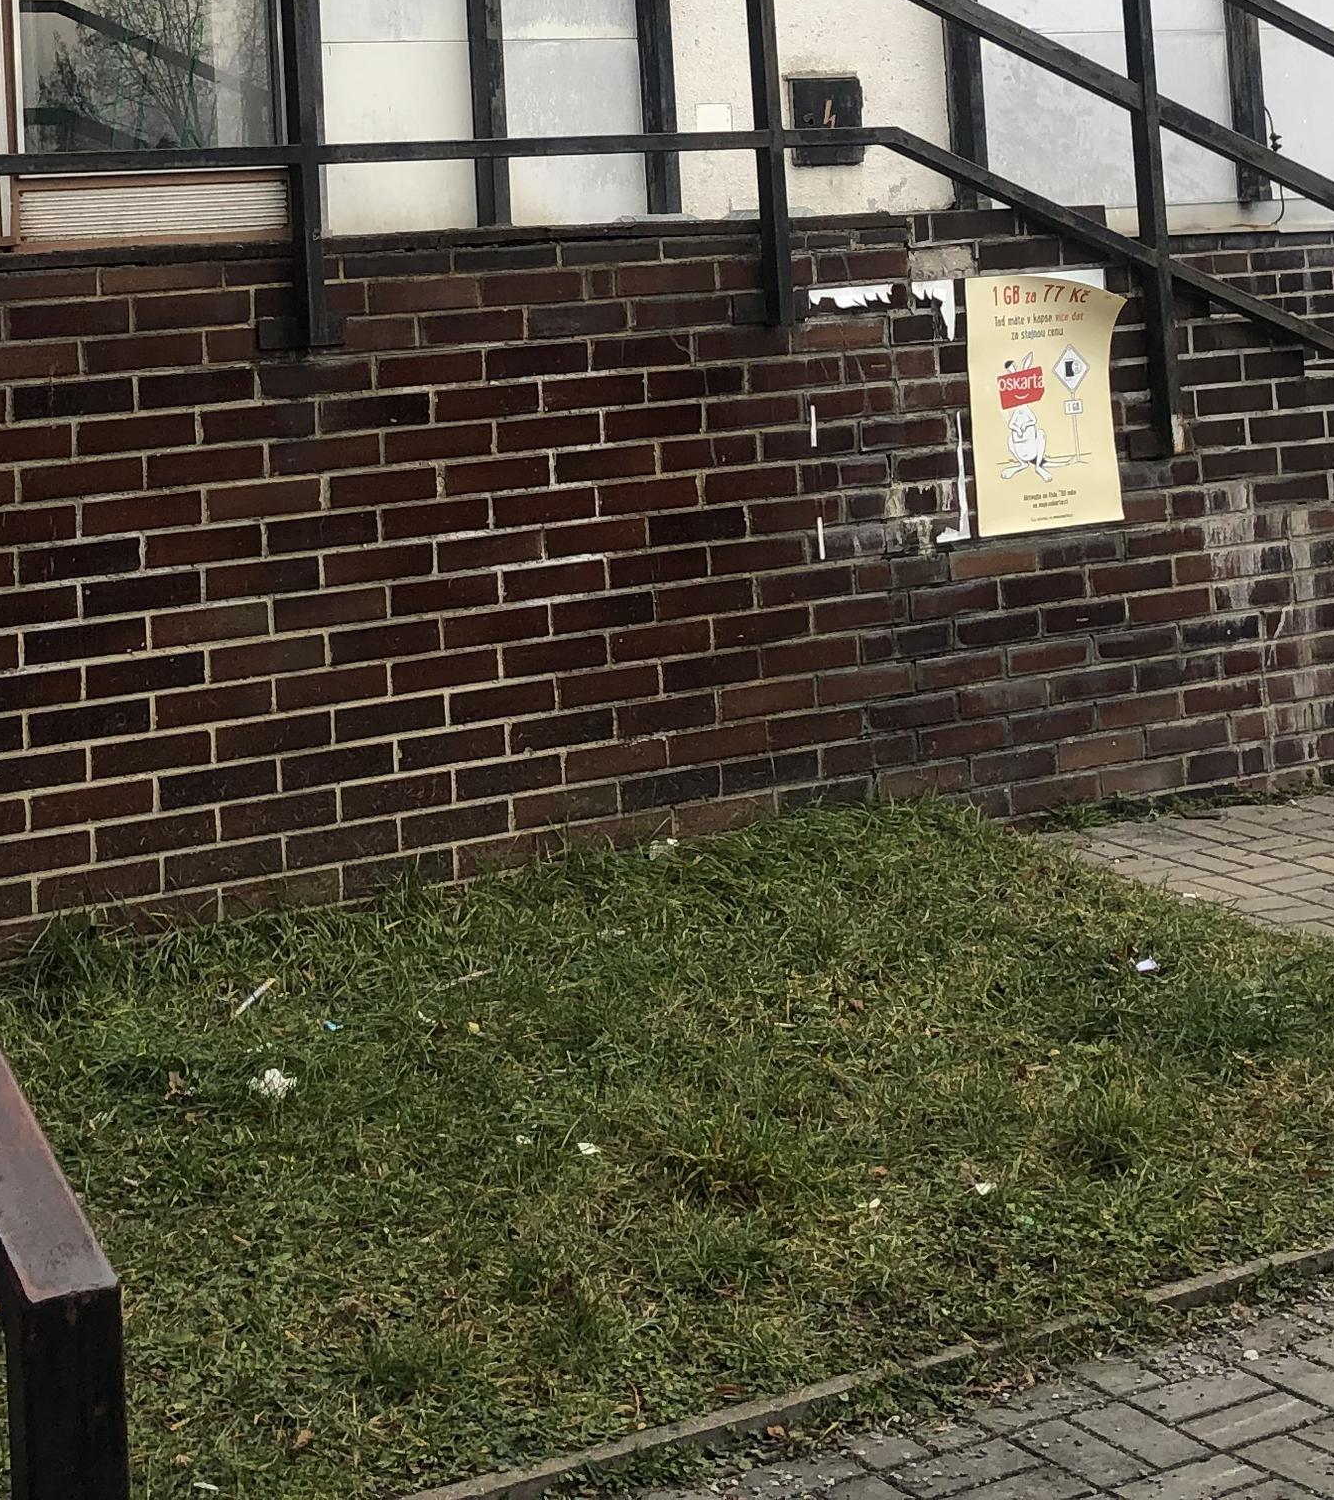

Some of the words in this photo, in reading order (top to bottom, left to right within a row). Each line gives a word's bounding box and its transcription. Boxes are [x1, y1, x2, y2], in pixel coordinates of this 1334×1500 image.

[993, 286, 998, 306] 1
[1003, 285, 1021, 306] GB
[1025, 291, 1037, 304] za
[1043, 284, 1066, 303] 77
[1069, 287, 1092, 304] Kč
[998, 373, 1045, 392] oskarta
